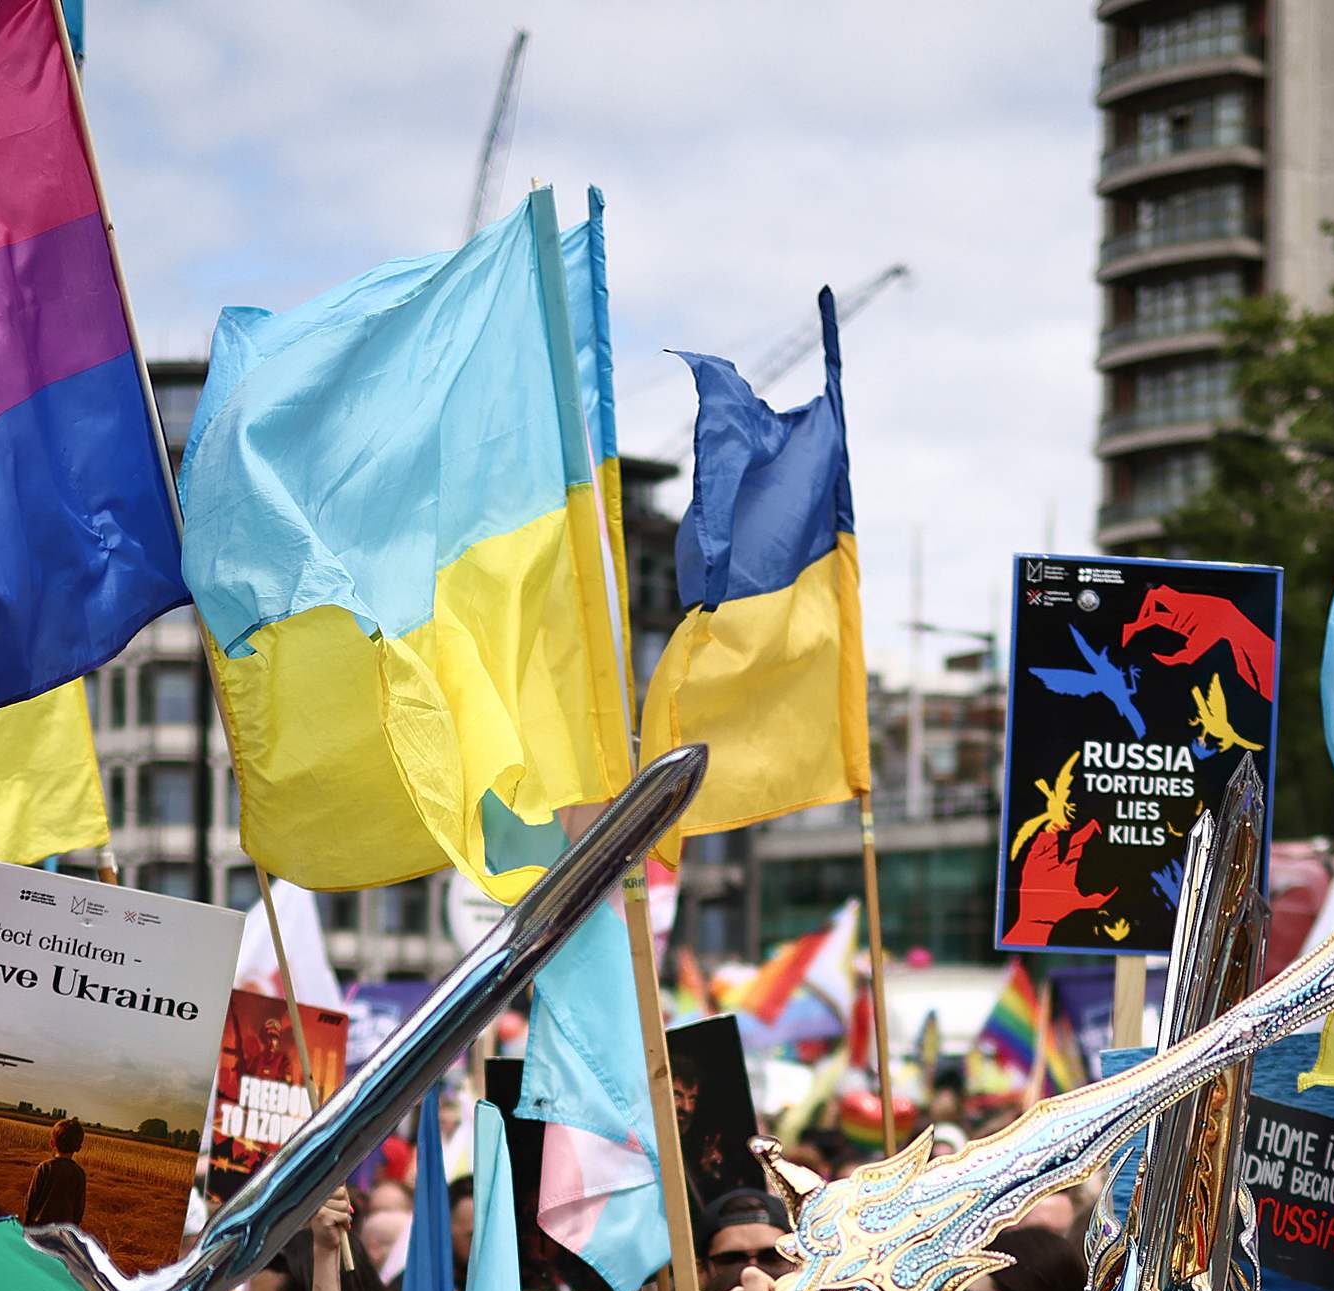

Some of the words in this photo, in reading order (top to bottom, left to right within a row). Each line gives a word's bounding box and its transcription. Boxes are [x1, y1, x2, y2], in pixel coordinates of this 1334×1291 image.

[1083, 740, 1195, 773] RUSSIA
[1083, 773, 1195, 798] TORTURES
[1116, 800, 1161, 821] LIES
[1108, 825, 1166, 847] KILLS
[38, 934, 125, 966] children
[52, 963, 199, 1021] Ukraine
[1257, 1117, 1319, 1167] HOME
